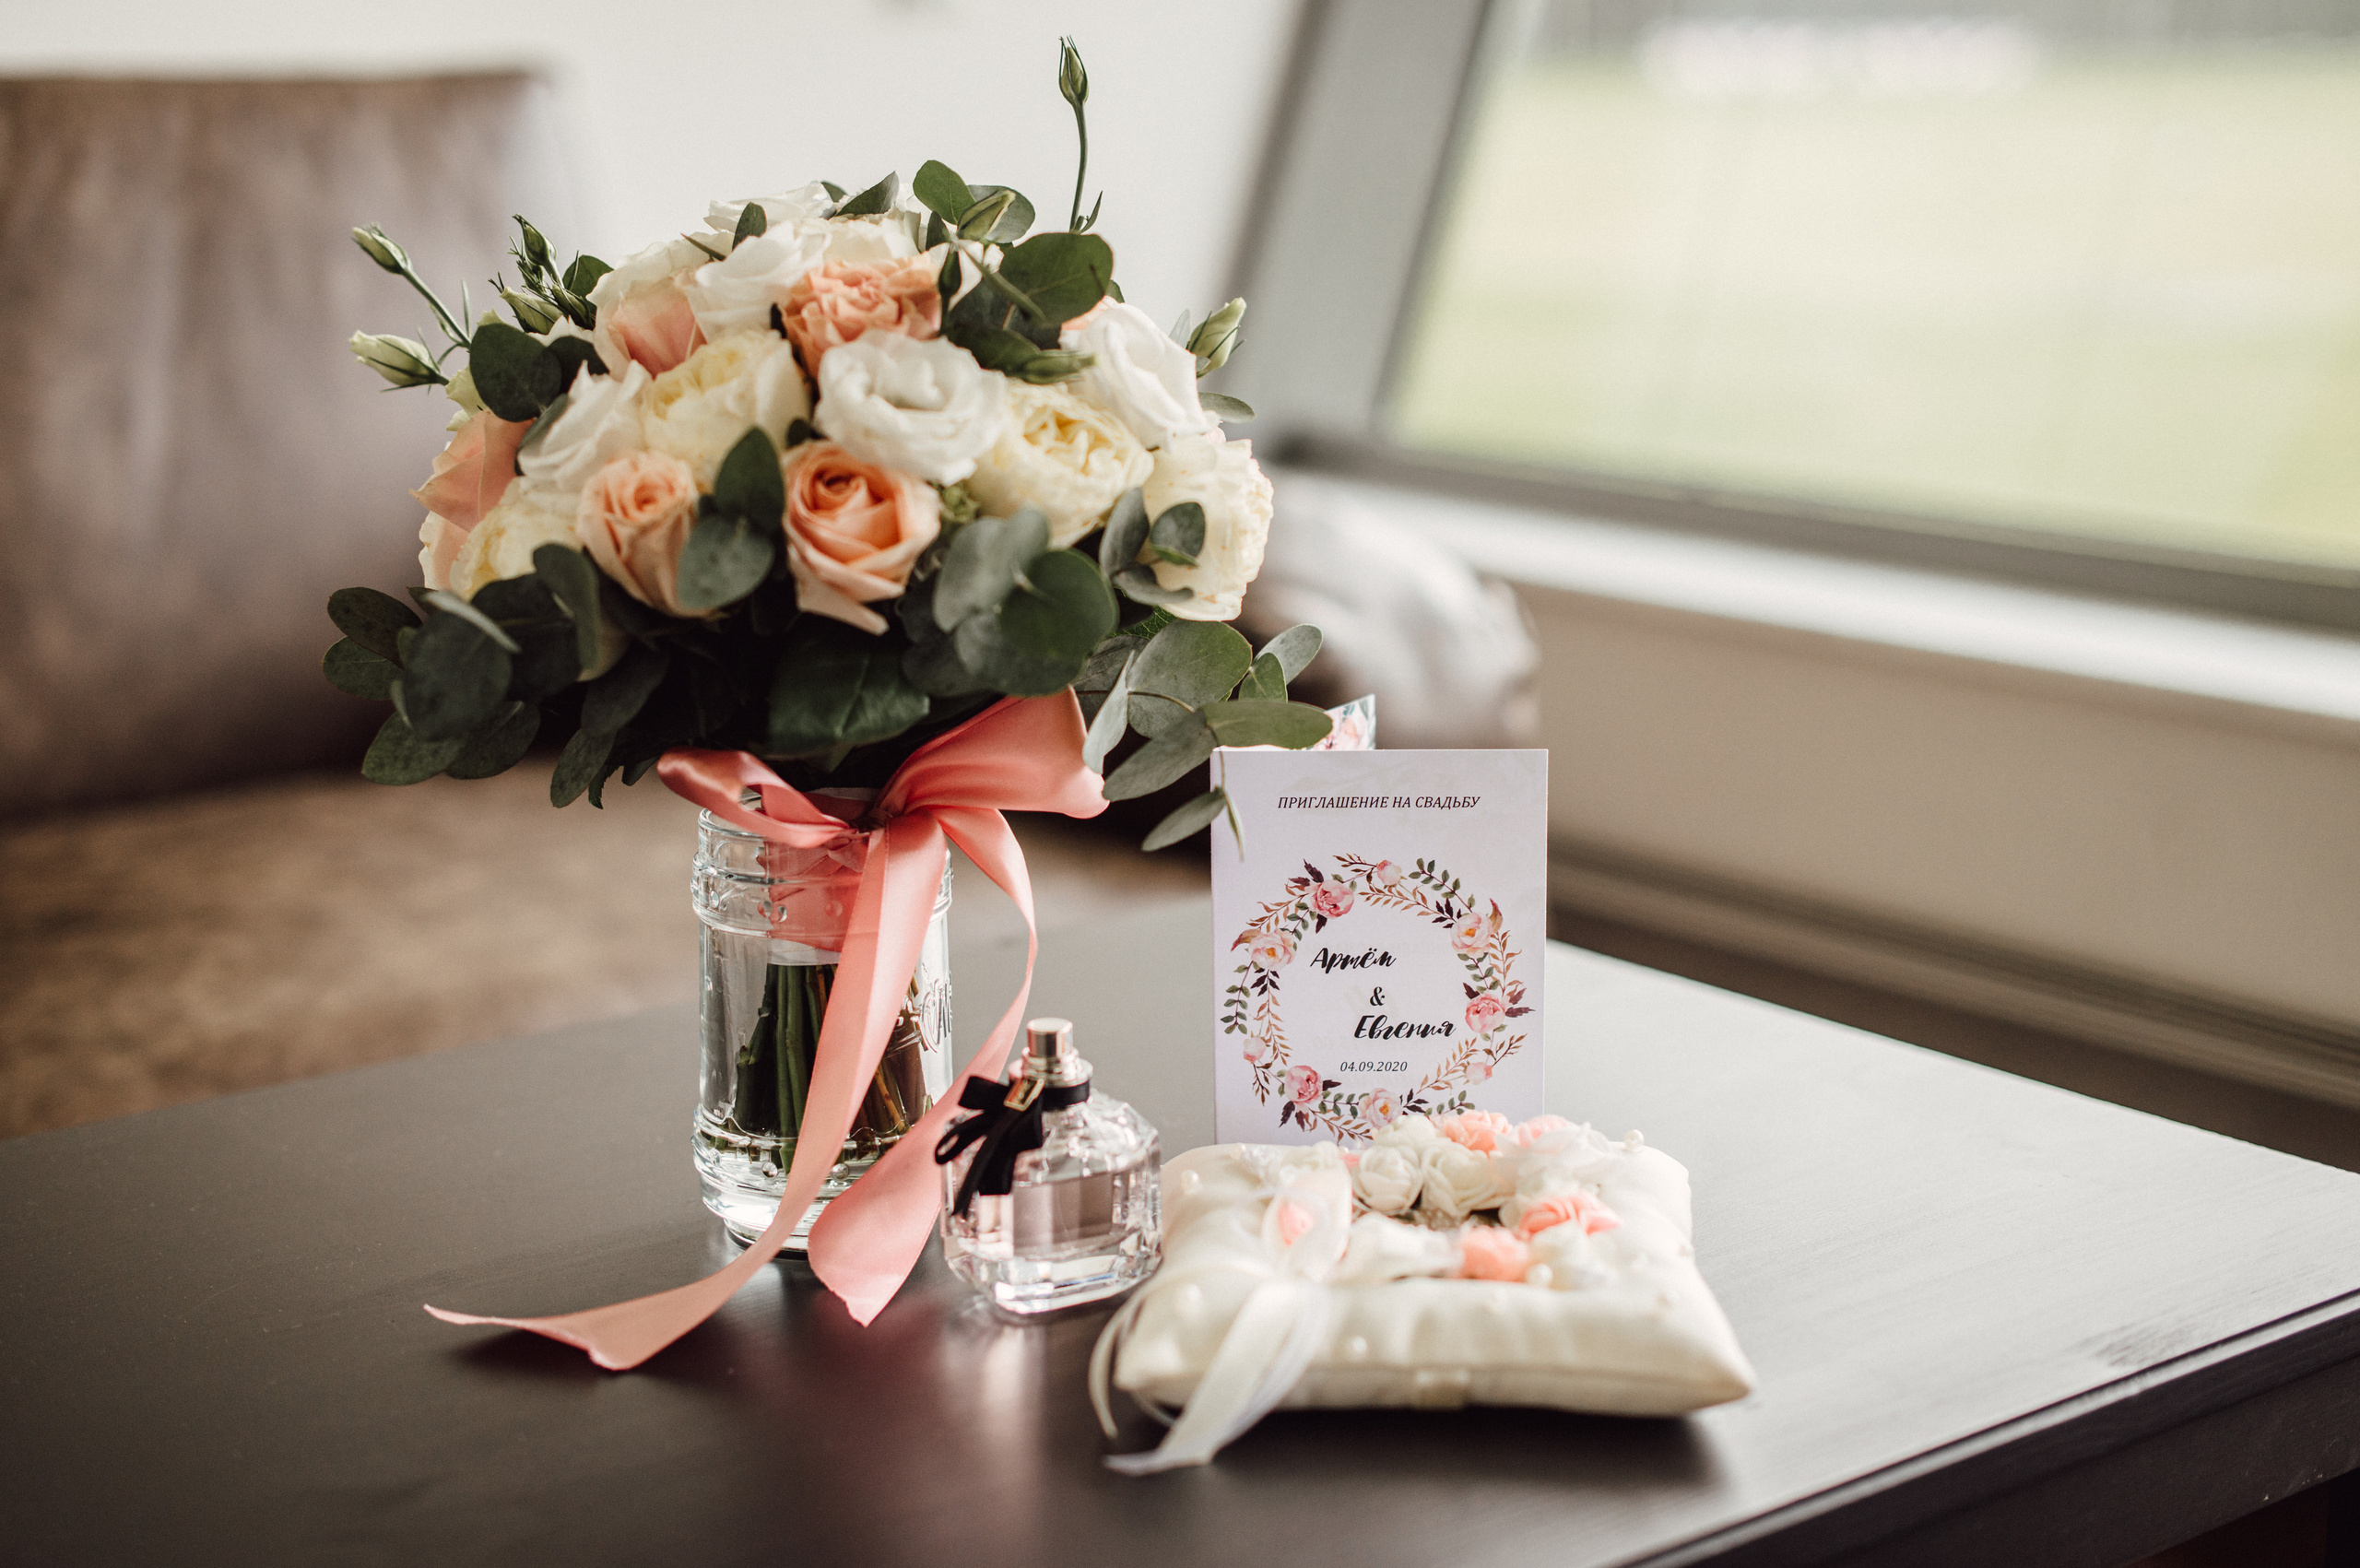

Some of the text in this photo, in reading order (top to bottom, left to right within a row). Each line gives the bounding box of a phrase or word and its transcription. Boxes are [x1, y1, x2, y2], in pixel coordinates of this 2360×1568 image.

[1278, 796, 1481, 810] ПРИГЛАШЕНИЕ НА СВАДЬБУ
[1310, 947, 1397, 974] Артём
[1369, 986, 1386, 1007] &
[1353, 1014, 1457, 1040] Евгения
[1339, 1061, 1408, 1072] 04.09.2020
